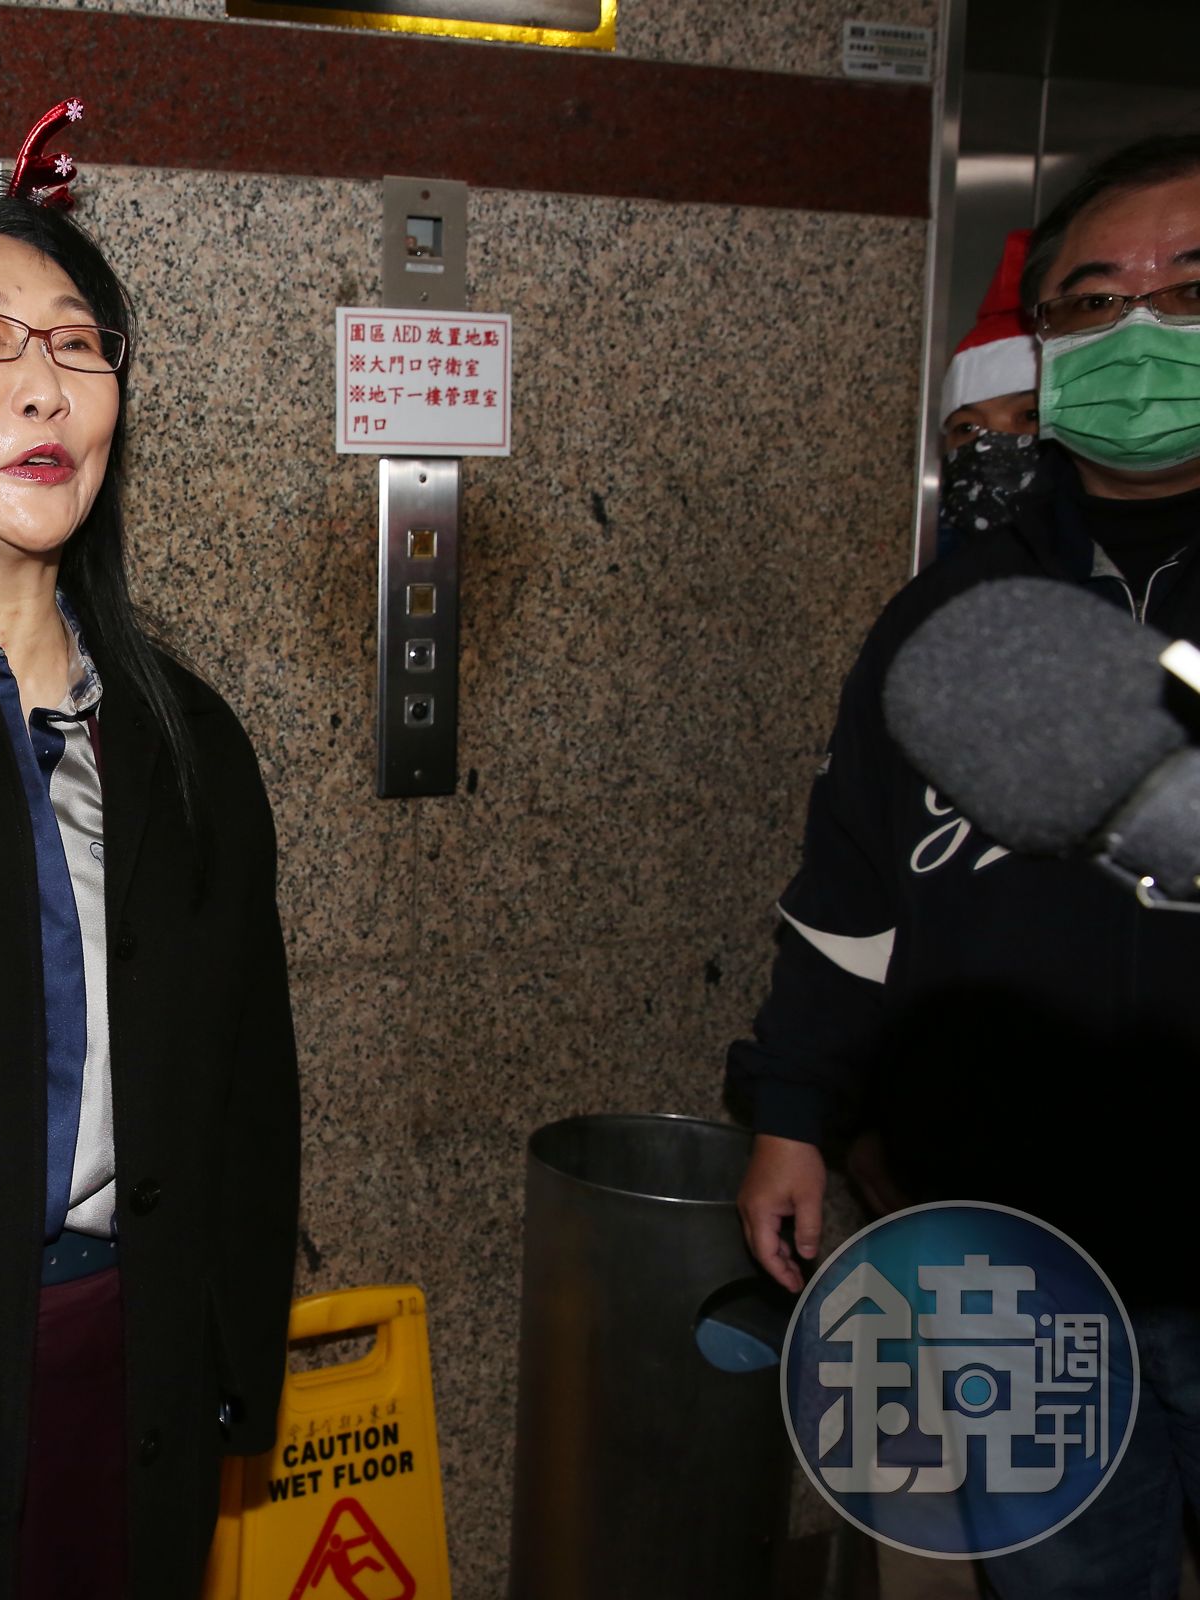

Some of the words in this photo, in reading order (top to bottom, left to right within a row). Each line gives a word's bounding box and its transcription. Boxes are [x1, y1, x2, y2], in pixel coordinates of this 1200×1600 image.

[393, 325, 422, 343] AED
[427, 326, 499, 346] 放置地點
[353, 415, 387, 434] 門口
[282, 1422, 399, 1468] CAUTION
[268, 1470, 322, 1503] WET
[333, 1450, 414, 1489] FLOOR
